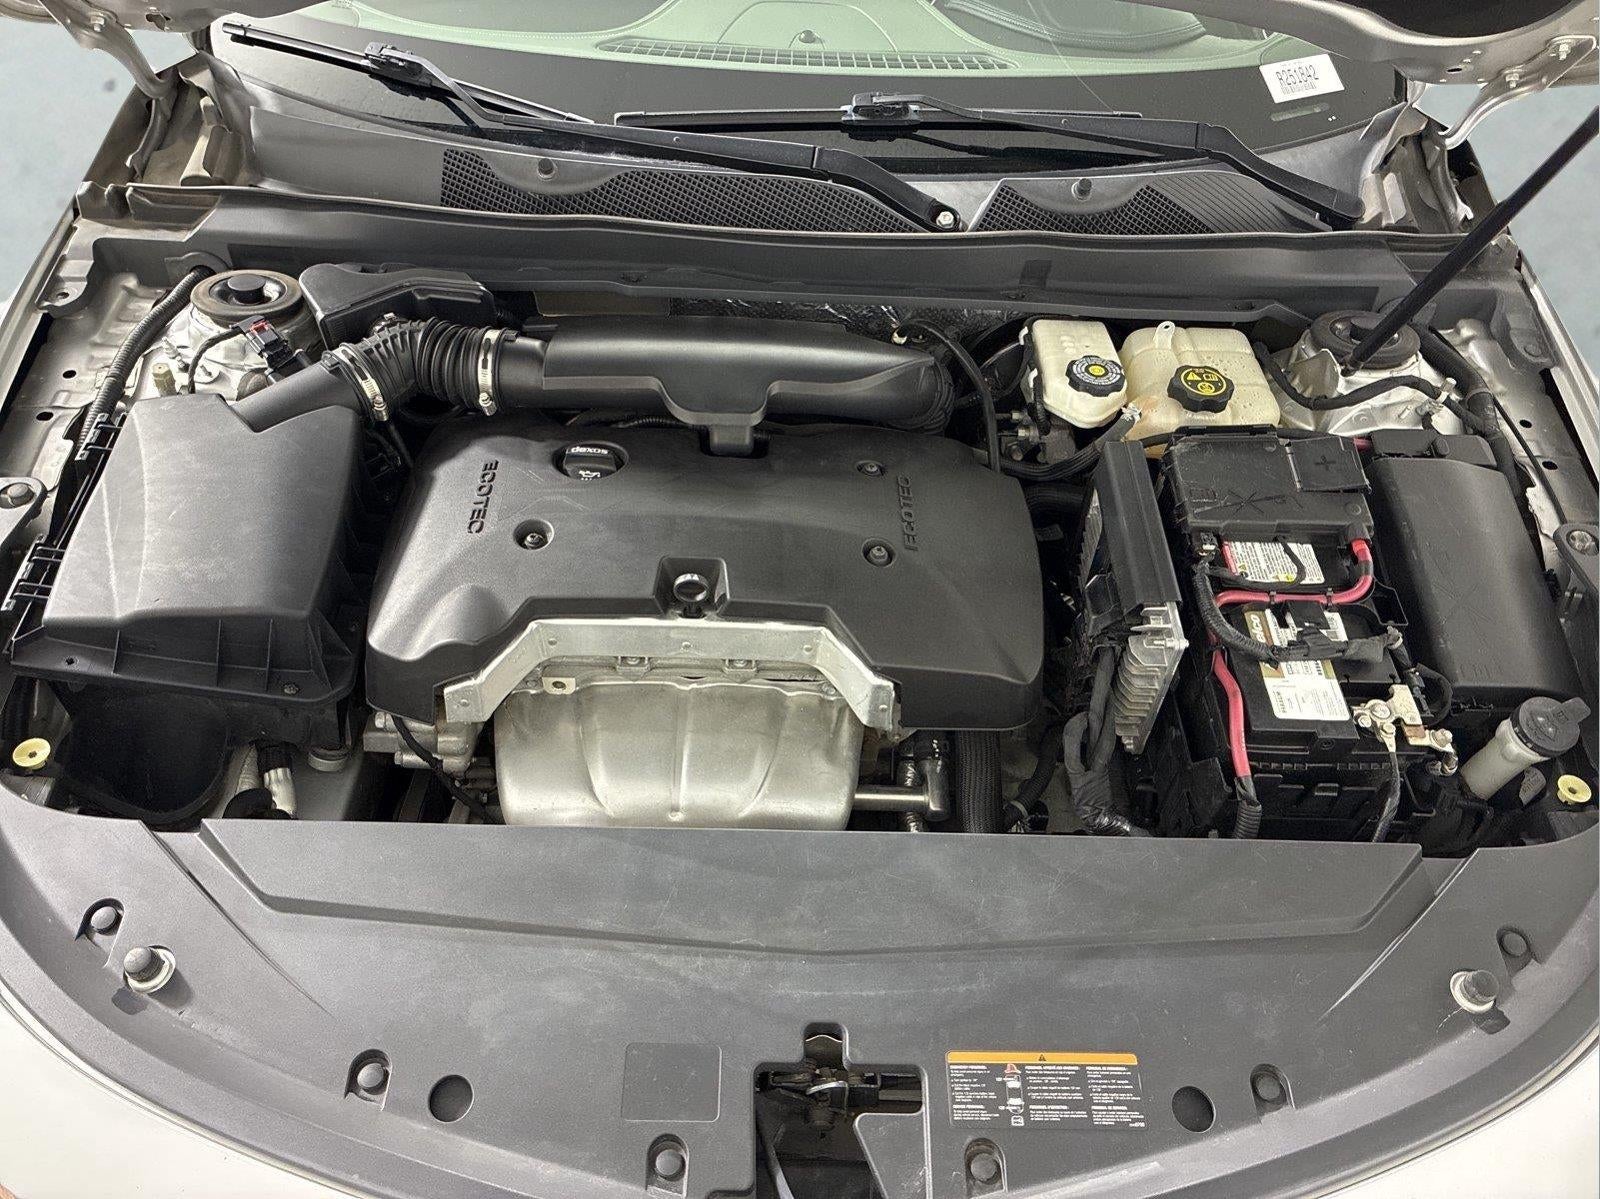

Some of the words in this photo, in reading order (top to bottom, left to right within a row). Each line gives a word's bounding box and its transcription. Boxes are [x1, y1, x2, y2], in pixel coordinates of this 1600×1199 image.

[1275, 64, 1320, 87] R251842
[570, 445, 609, 455] dexos
[467, 459, 499, 534] ECOTEC
[897, 474, 919, 551] ECOTEC
